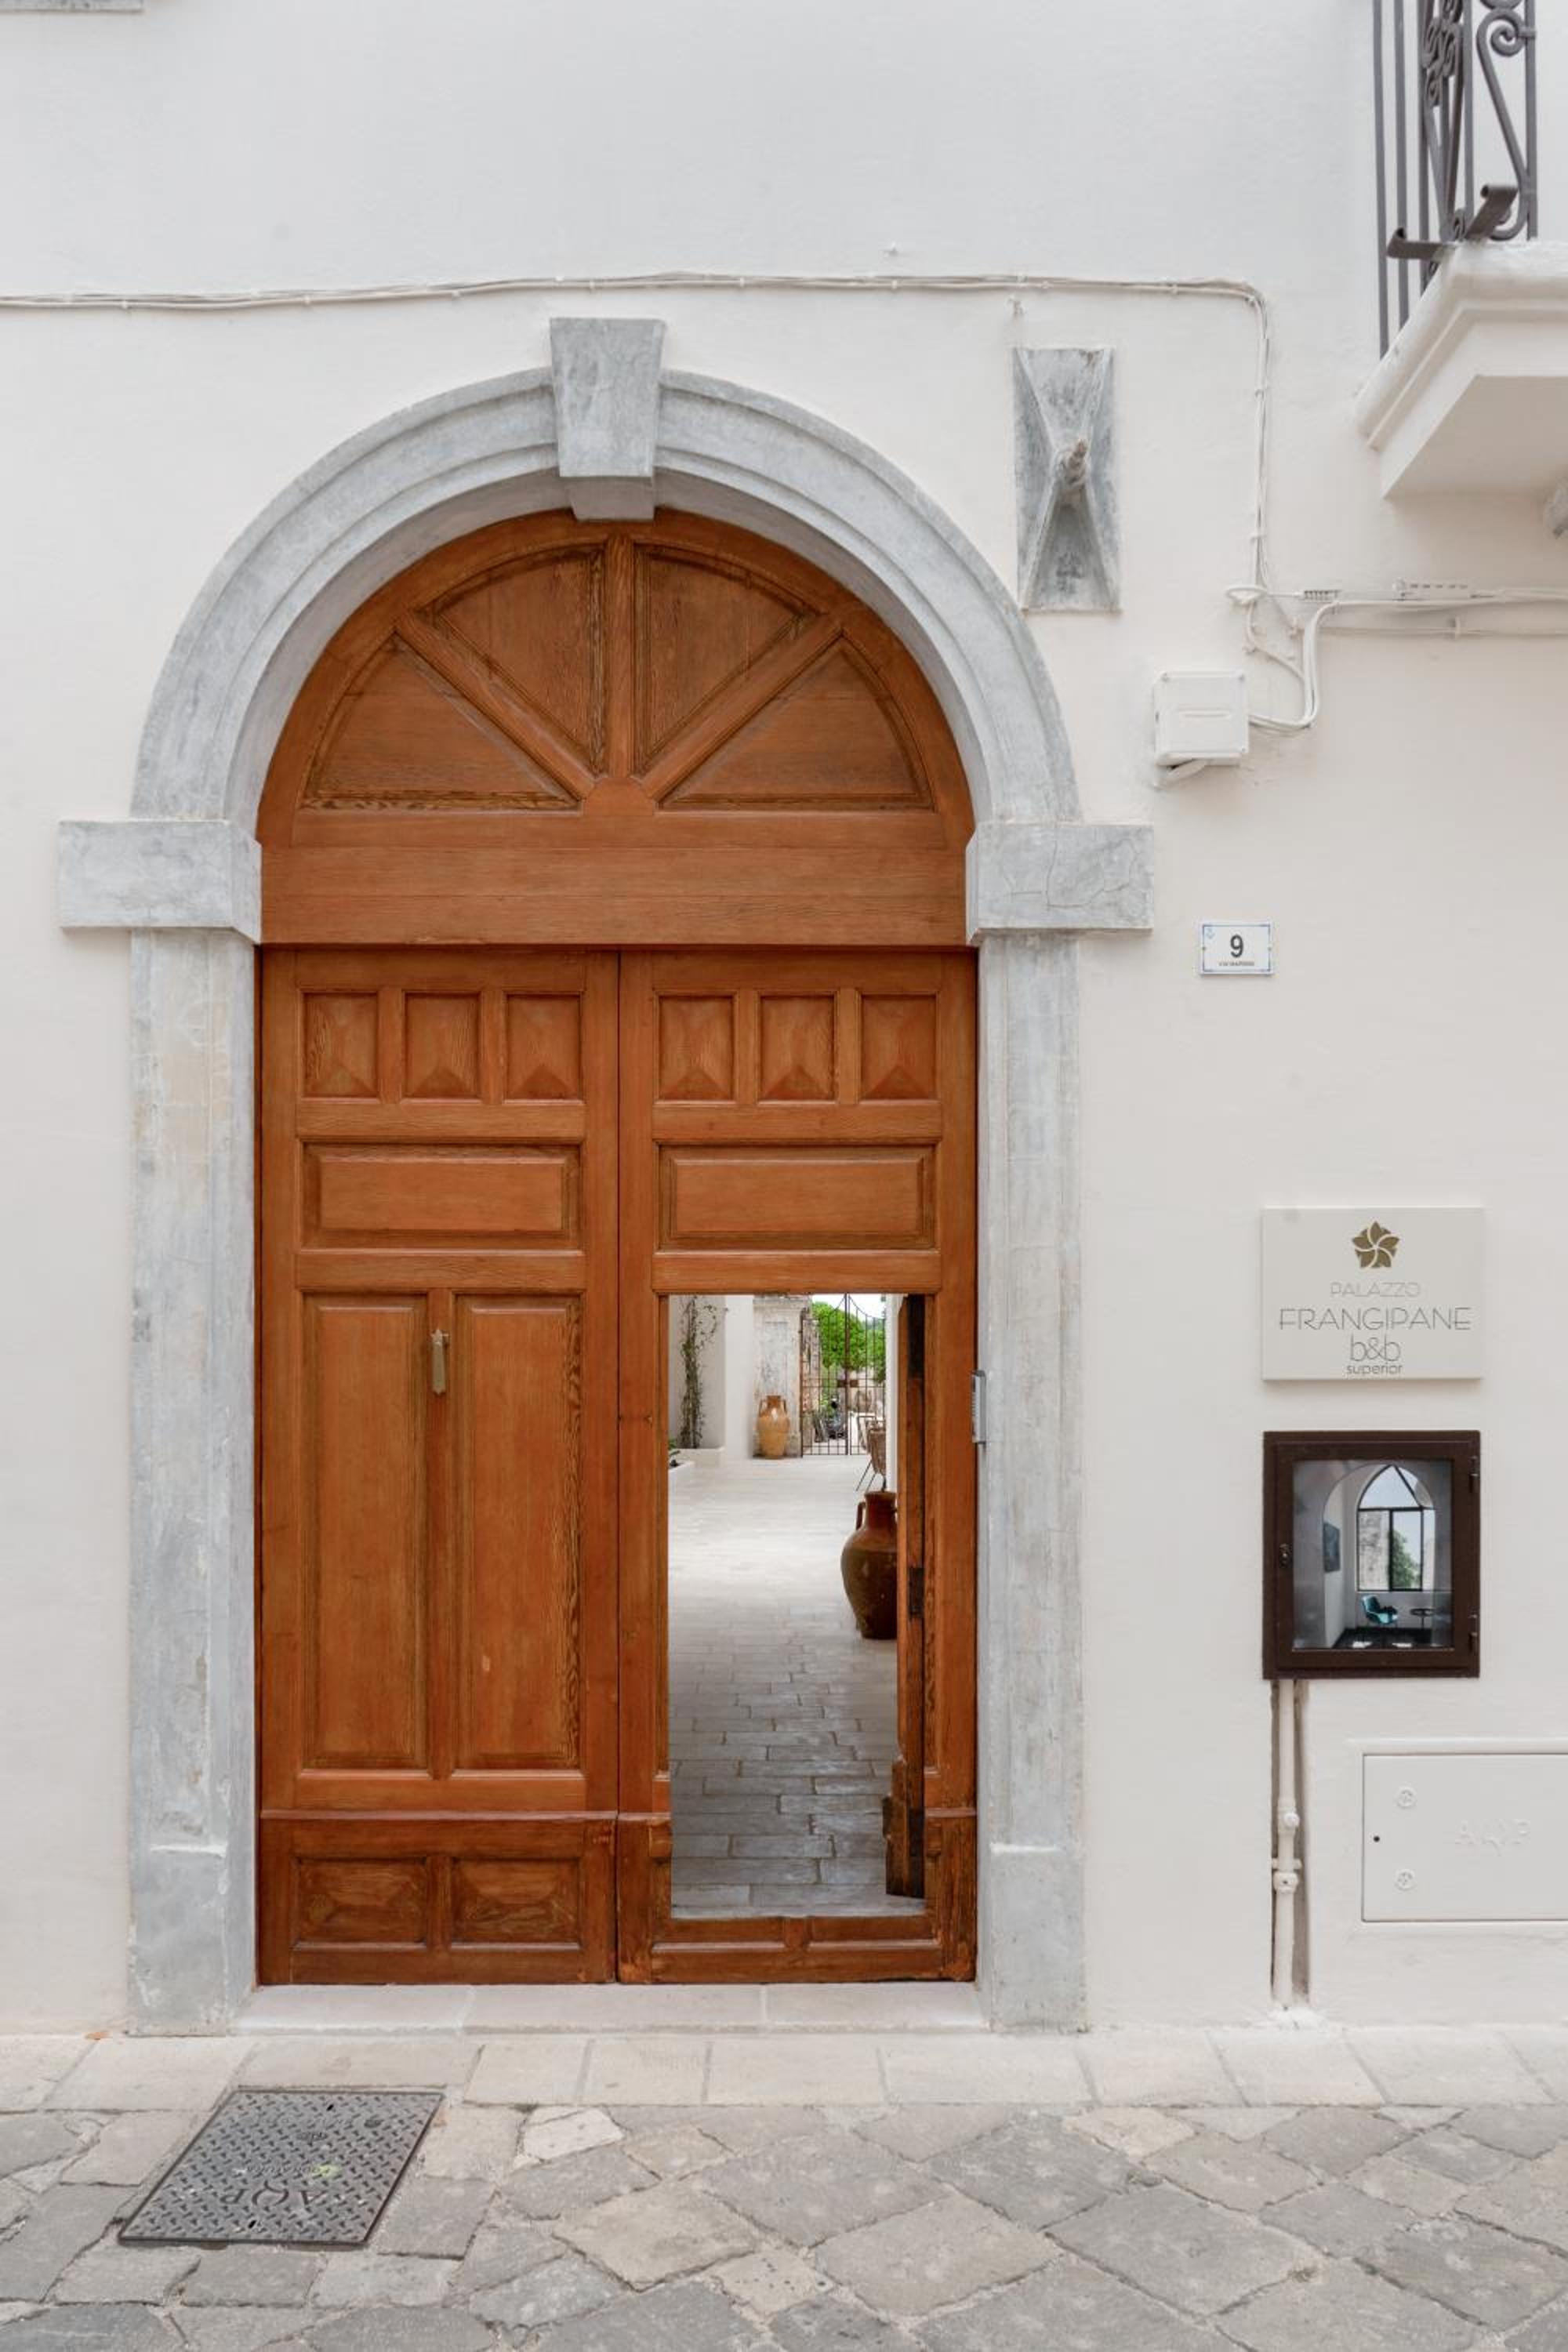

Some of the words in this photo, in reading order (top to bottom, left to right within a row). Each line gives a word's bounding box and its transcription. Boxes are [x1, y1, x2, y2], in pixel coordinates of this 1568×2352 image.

[1230, 934, 1243, 958] 9
[1330, 1282, 1421, 1297] PALAZZO
[1279, 1307, 1472, 1330] FRANGIPANE
[1350, 1334, 1401, 1362] b&b
[1346, 1363, 1403, 1376] superior
[220, 2180, 328, 2205] AQP
